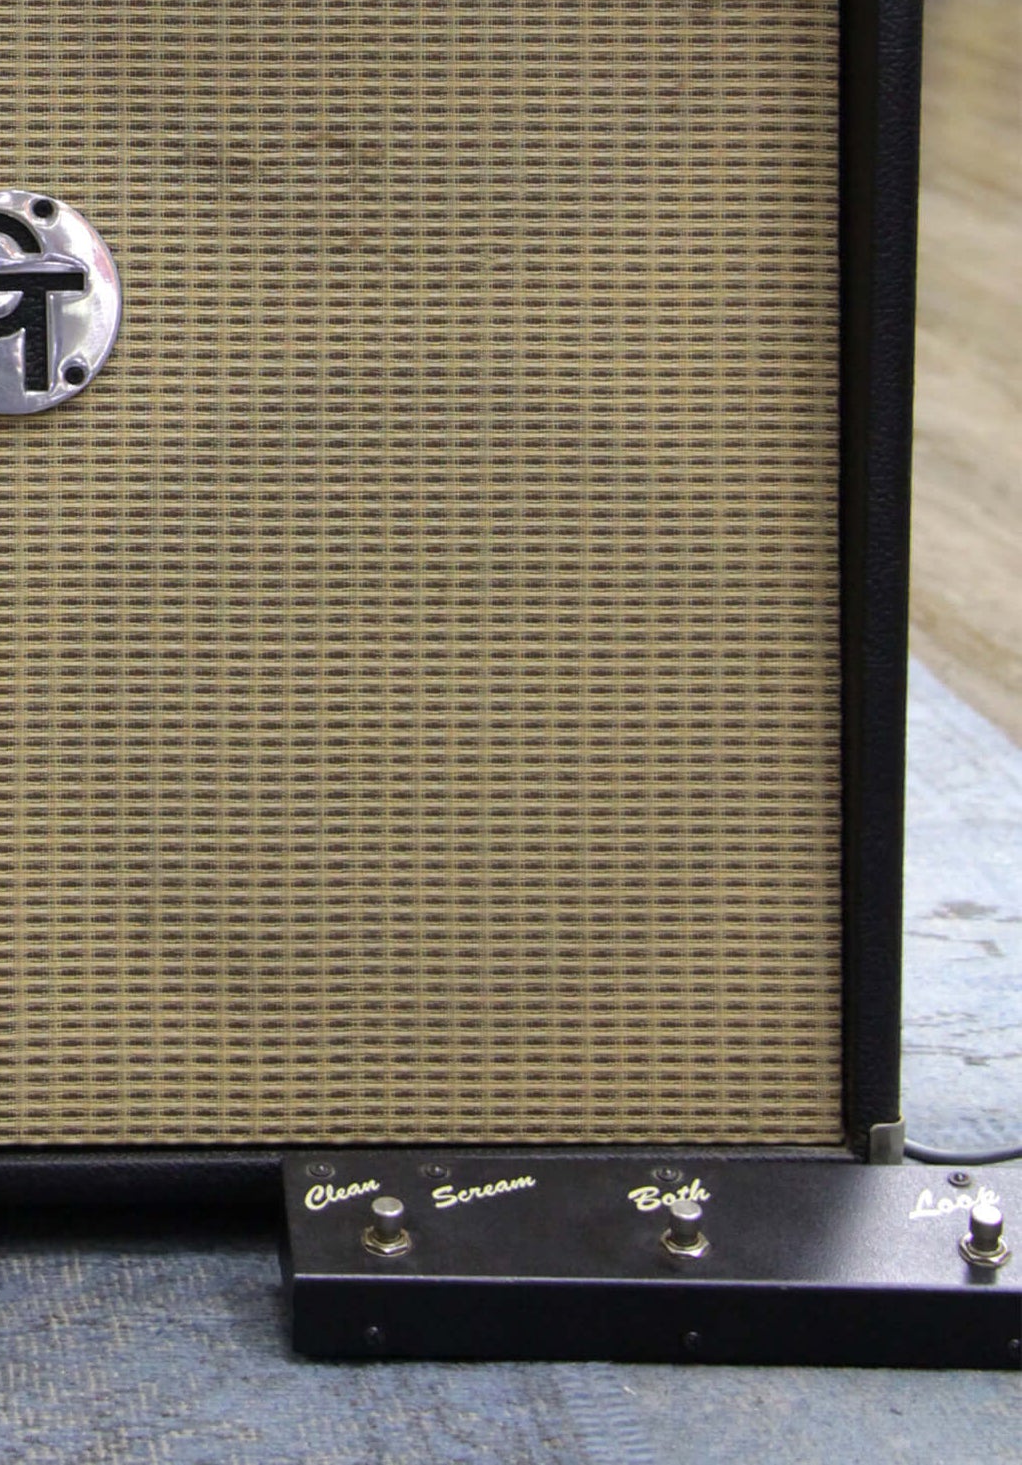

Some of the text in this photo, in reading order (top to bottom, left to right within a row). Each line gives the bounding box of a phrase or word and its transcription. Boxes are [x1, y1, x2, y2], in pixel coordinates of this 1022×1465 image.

[304, 1178, 380, 1211] Clean
[431, 1174, 537, 1209] Scream
[627, 1178, 711, 1212] Both
